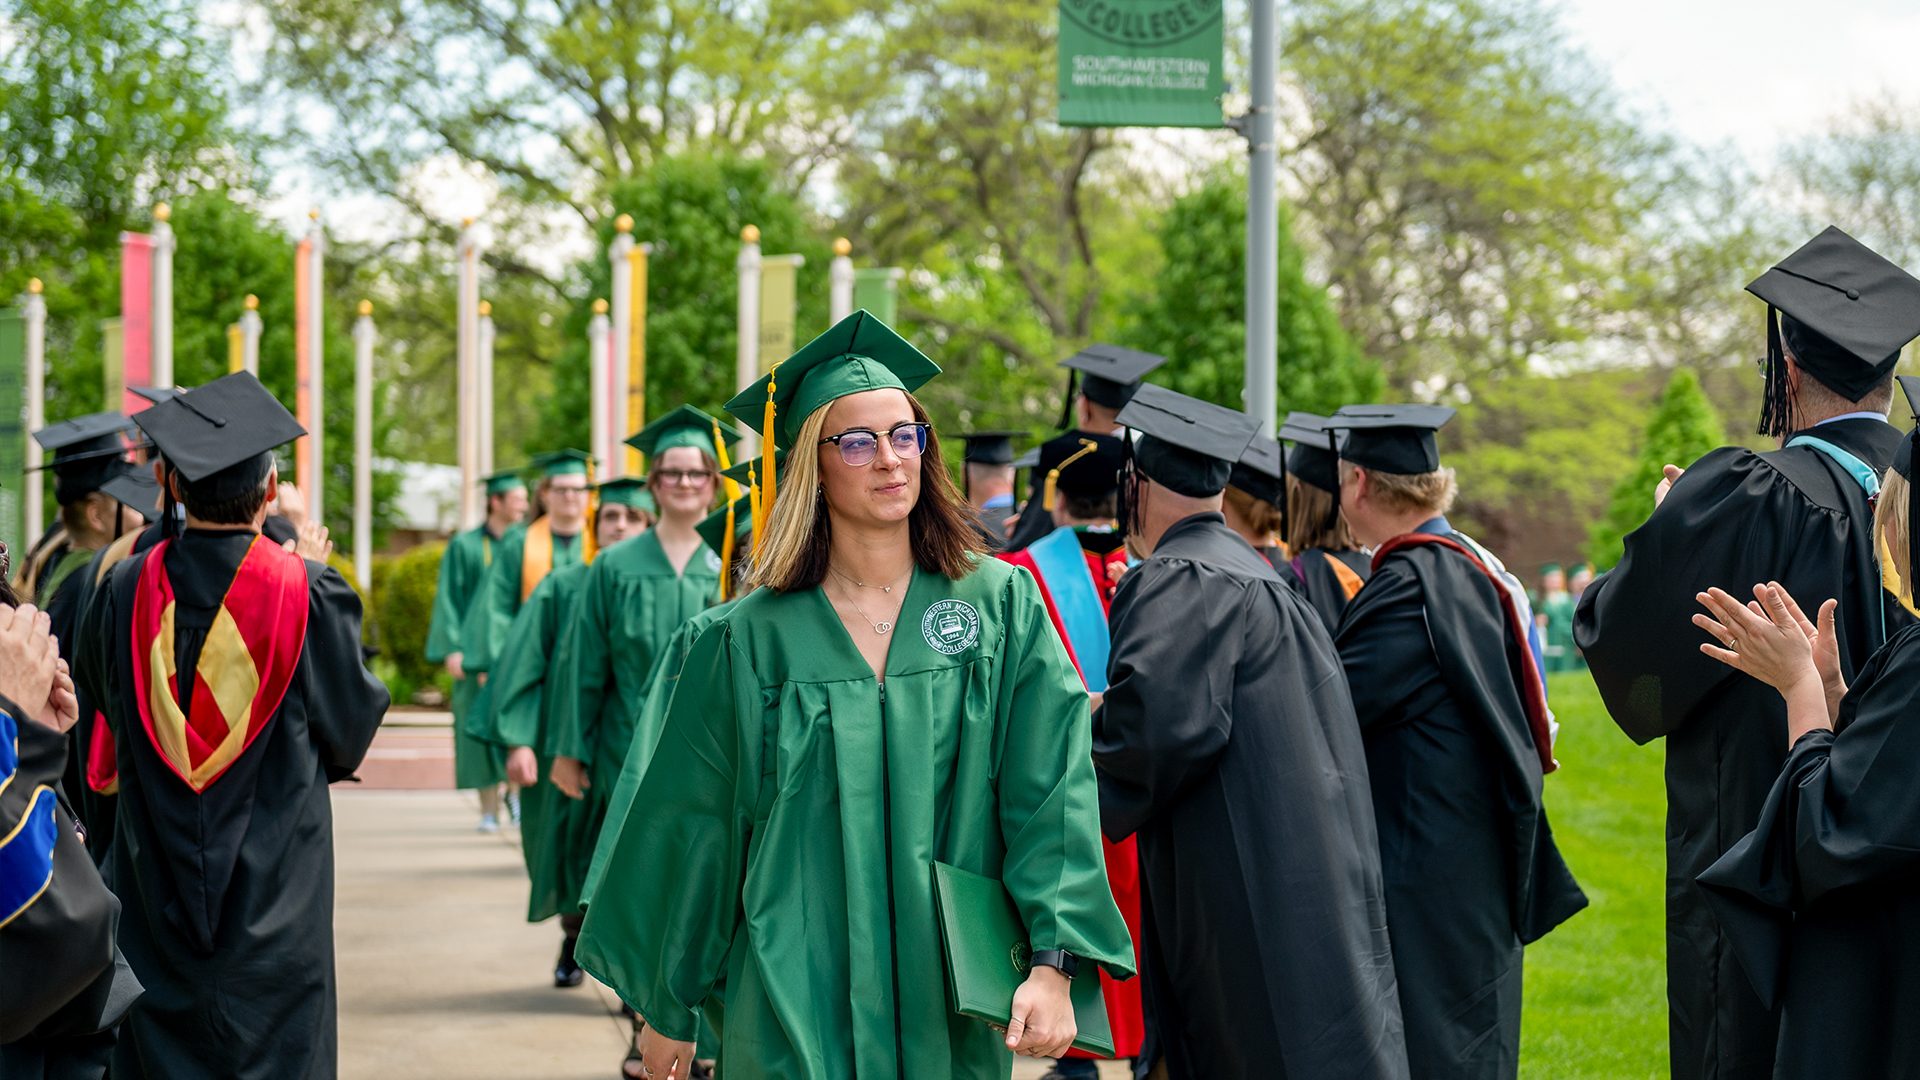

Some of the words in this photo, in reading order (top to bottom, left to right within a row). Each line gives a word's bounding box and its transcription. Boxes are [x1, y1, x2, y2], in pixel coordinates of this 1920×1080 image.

[1088, 2, 1197, 38] COLLEGE
[1072, 55, 1210, 74] SOUTHWESTERN
[1072, 72, 1144, 87] MICHIGAN
[1146, 75, 1206, 89] COLLEGE
[925, 602, 951, 637] SOUTHWESTERN
[955, 603, 977, 626] MICHIGAN
[946, 632, 959, 640] 1964
[942, 638, 970, 653] COLLEGE
